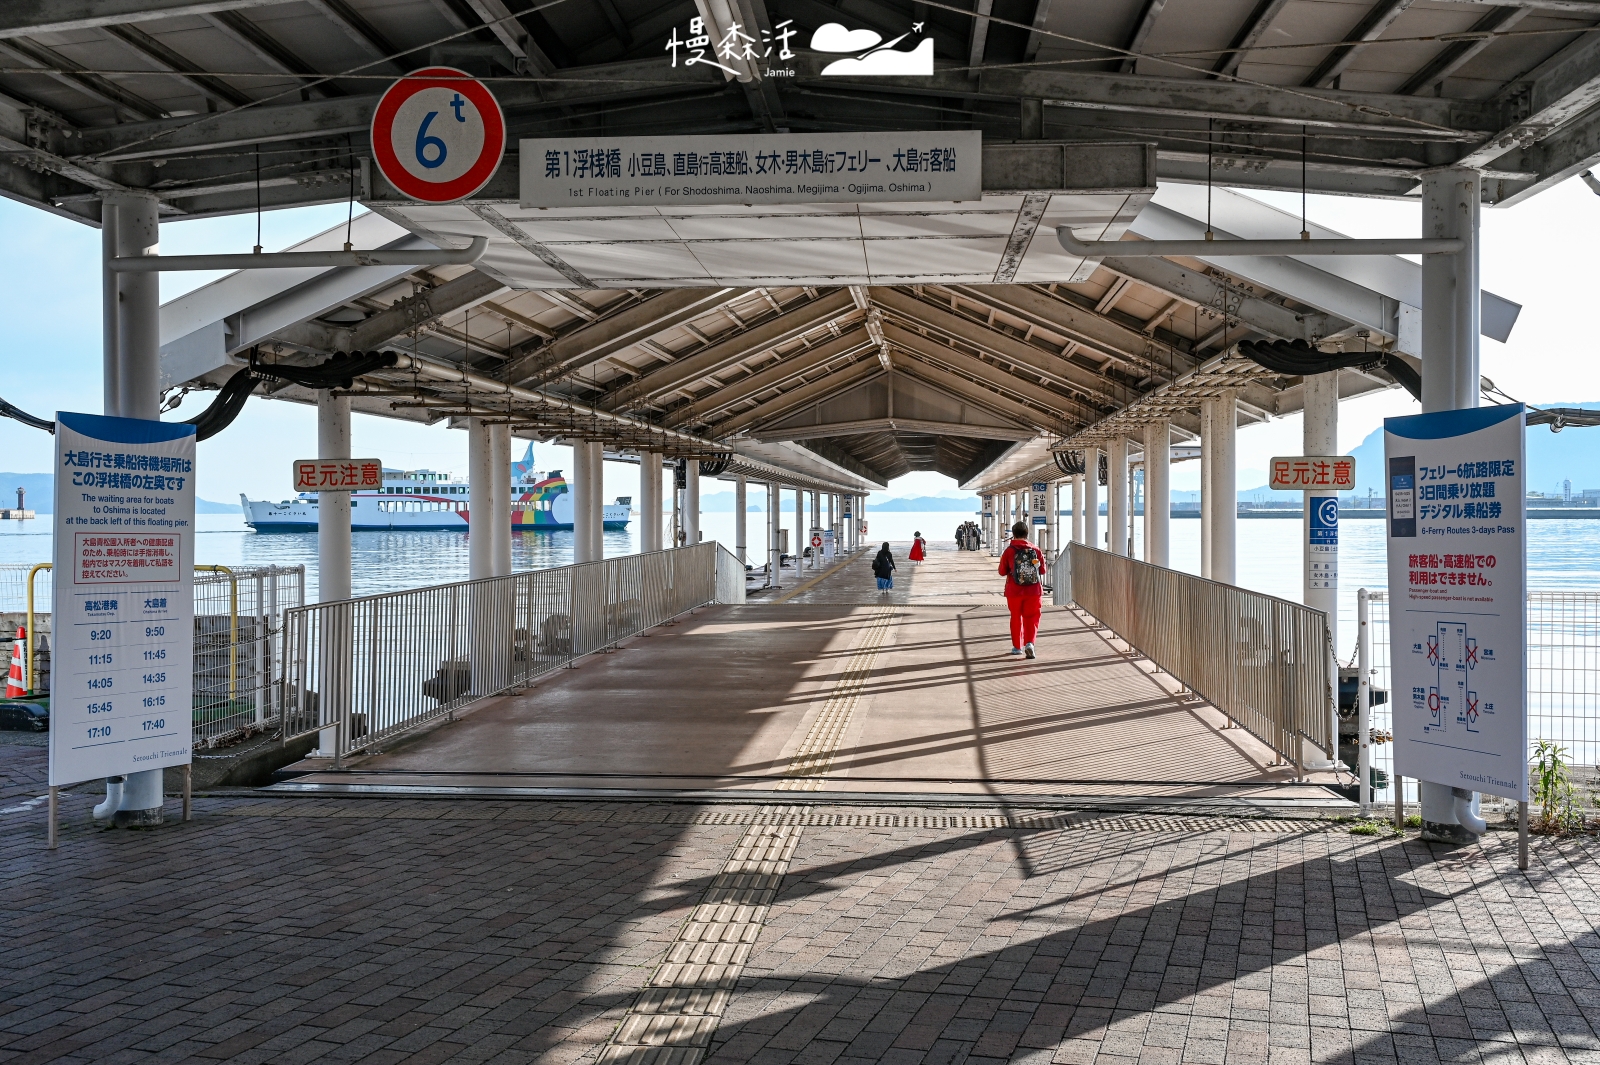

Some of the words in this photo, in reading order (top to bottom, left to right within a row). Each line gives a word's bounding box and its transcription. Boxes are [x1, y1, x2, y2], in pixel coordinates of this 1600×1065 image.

[545, 148, 622, 179] 第1浮桟橋
[568, 187, 583, 197] 1st
[588, 187, 630, 198] Floating
[634, 186, 655, 197] Pier
[64, 450, 192, 473] 大島行き乗船待機場所は
[1419, 459, 1515, 481] フェリー6航路限定
[72, 471, 186, 491] この浮桟橋の左奥です
[297, 462, 379, 487] 足元注意
[1271, 460, 1352, 485] 足元注意
[81, 493, 96, 502] The
[97, 494, 124, 504] waiting
[126, 496, 141, 504] area
[143, 495, 153, 504] for
[155, 496, 175, 505] boats
[1418, 481, 1496, 501] 3日間乗り放題
[93, 506, 101, 514] to
[102, 505, 131, 514] Oshima
[132, 506, 139, 515] is
[140, 506, 166, 515] located
[1419, 501, 1502, 520] デジタル乗船券
[65, 517, 74, 525] at
[75, 516, 88, 525] the
[89, 517, 108, 525] back
[110, 517, 122, 525] left
[123, 517, 132, 526] of
[132, 517, 146, 526] this
[147, 517, 173, 528] floating
[174, 518, 189, 528] pier.
[1421, 526, 1446, 536] 6-Ferry
[1446, 526, 1471, 535] Routes
[1471, 525, 1496, 535] 3-days
[1497, 525, 1515, 534] Pass
[1408, 553, 1497, 569] 旅客船・高速船での
[81, 569, 128, 579] 控えてください。
[1408, 570, 1493, 587] 利用はできません。
[84, 599, 118, 612] 高松港発
[90, 629, 112, 641] 9:20
[145, 626, 165, 637] 9:50
[88, 653, 113, 666] 11:15
[143, 649, 166, 661] 11:45
[87, 677, 113, 690] 14:05
[142, 672, 166, 684] 14:35
[86, 701, 113, 714] 15:45
[142, 695, 166, 708] 16:15
[87, 725, 111, 739] 17:10
[141, 718, 165, 731] 17:40
[132, 751, 159, 763] Setouchi
[160, 747, 188, 759] Triennale
[1459, 770, 1486, 783] Setouchi
[1486, 775, 1518, 790] Triennale
